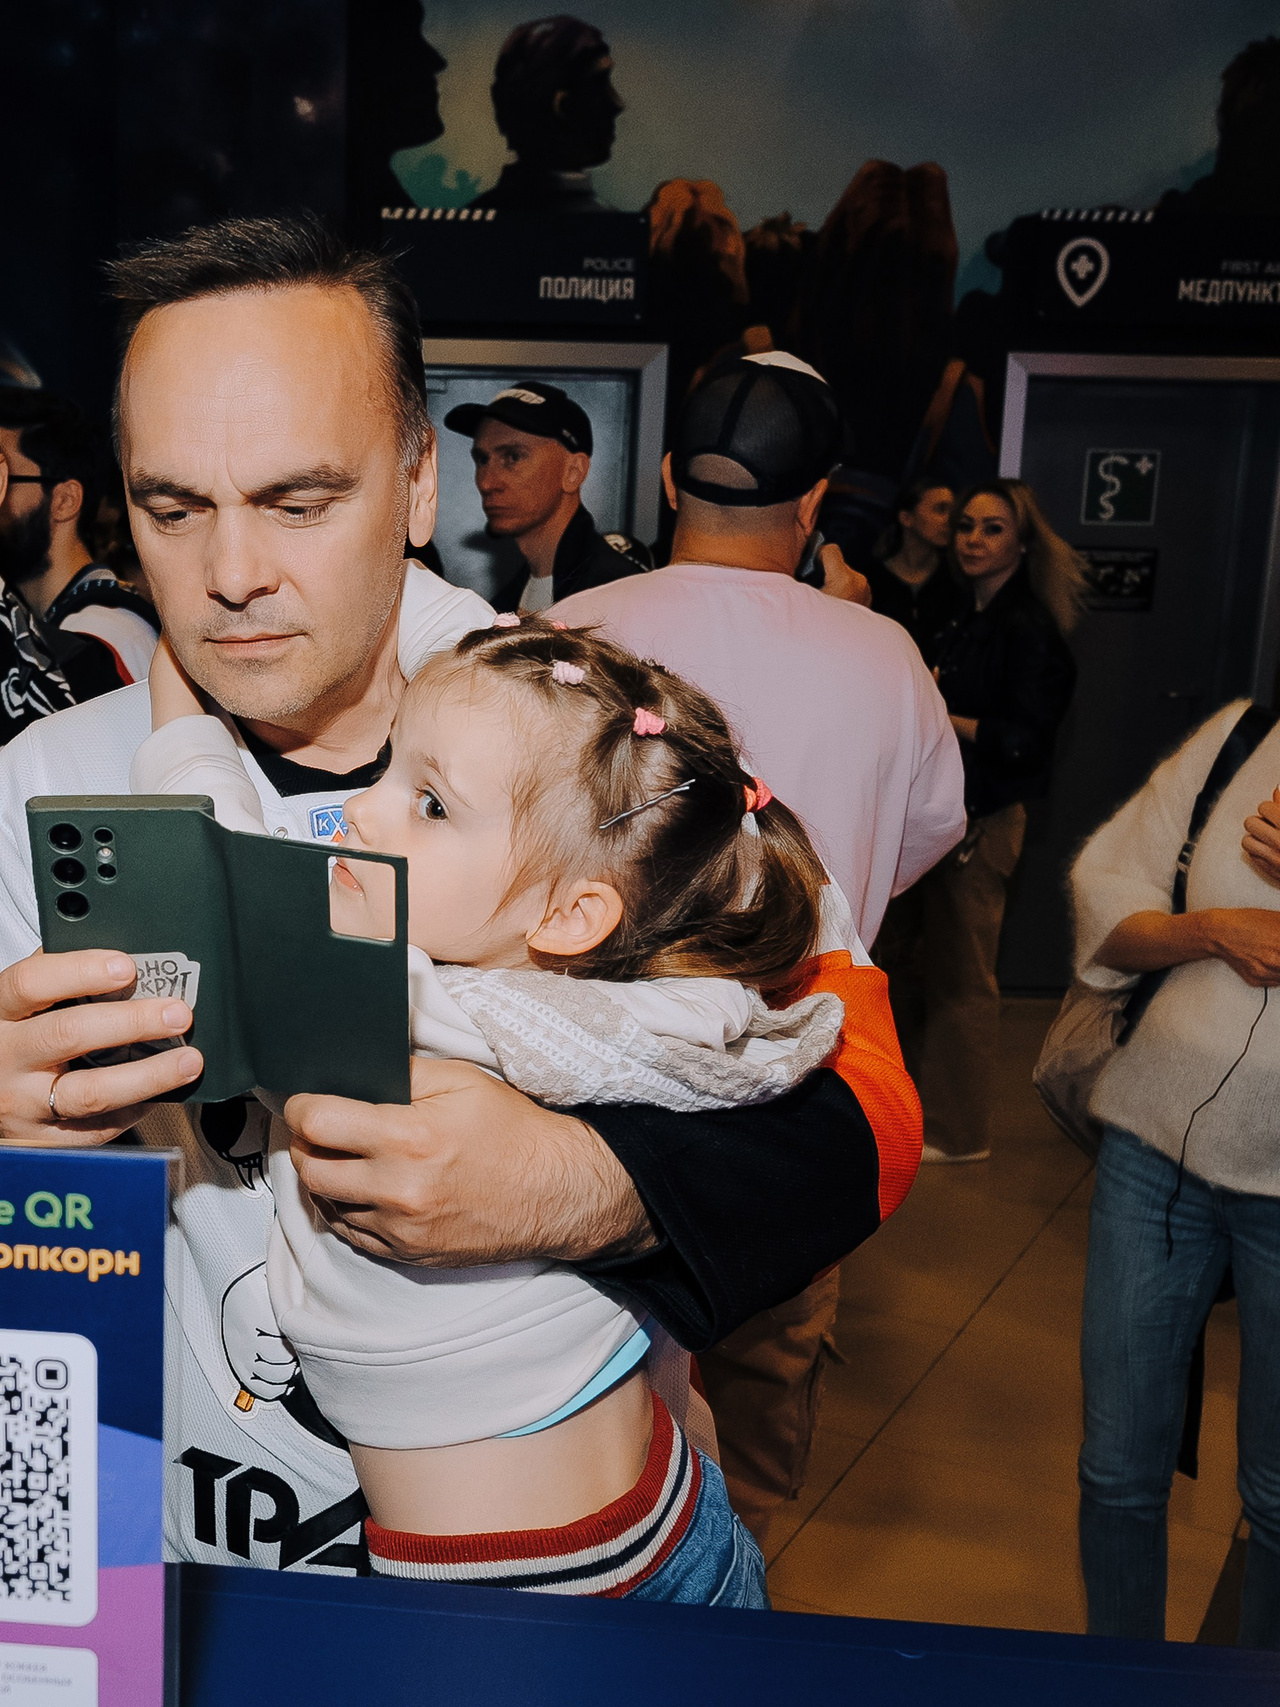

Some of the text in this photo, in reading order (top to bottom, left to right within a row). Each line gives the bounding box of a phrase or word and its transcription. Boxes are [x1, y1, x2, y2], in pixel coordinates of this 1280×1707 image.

[583, 258, 634, 271] POLICE
[539, 276, 634, 303] ПОЛИЦИЯ
[24, 1191, 94, 1230] QR
